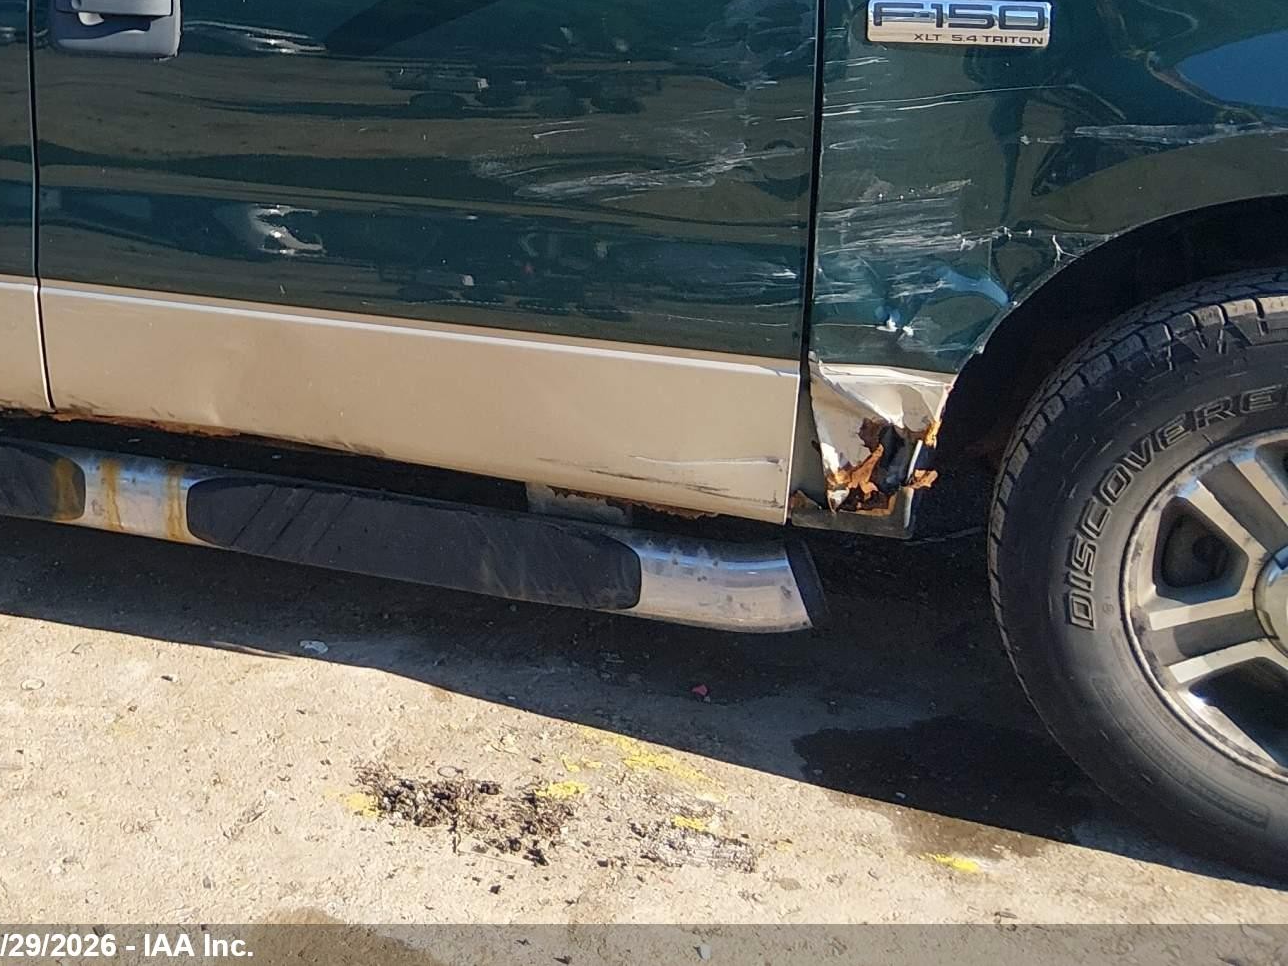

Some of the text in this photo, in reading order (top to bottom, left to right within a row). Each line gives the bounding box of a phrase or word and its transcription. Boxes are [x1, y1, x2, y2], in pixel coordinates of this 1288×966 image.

[913, 33, 1044, 45] XLT 5.4 TRITON
[1068, 384, 1288, 630] DISCOVERE
